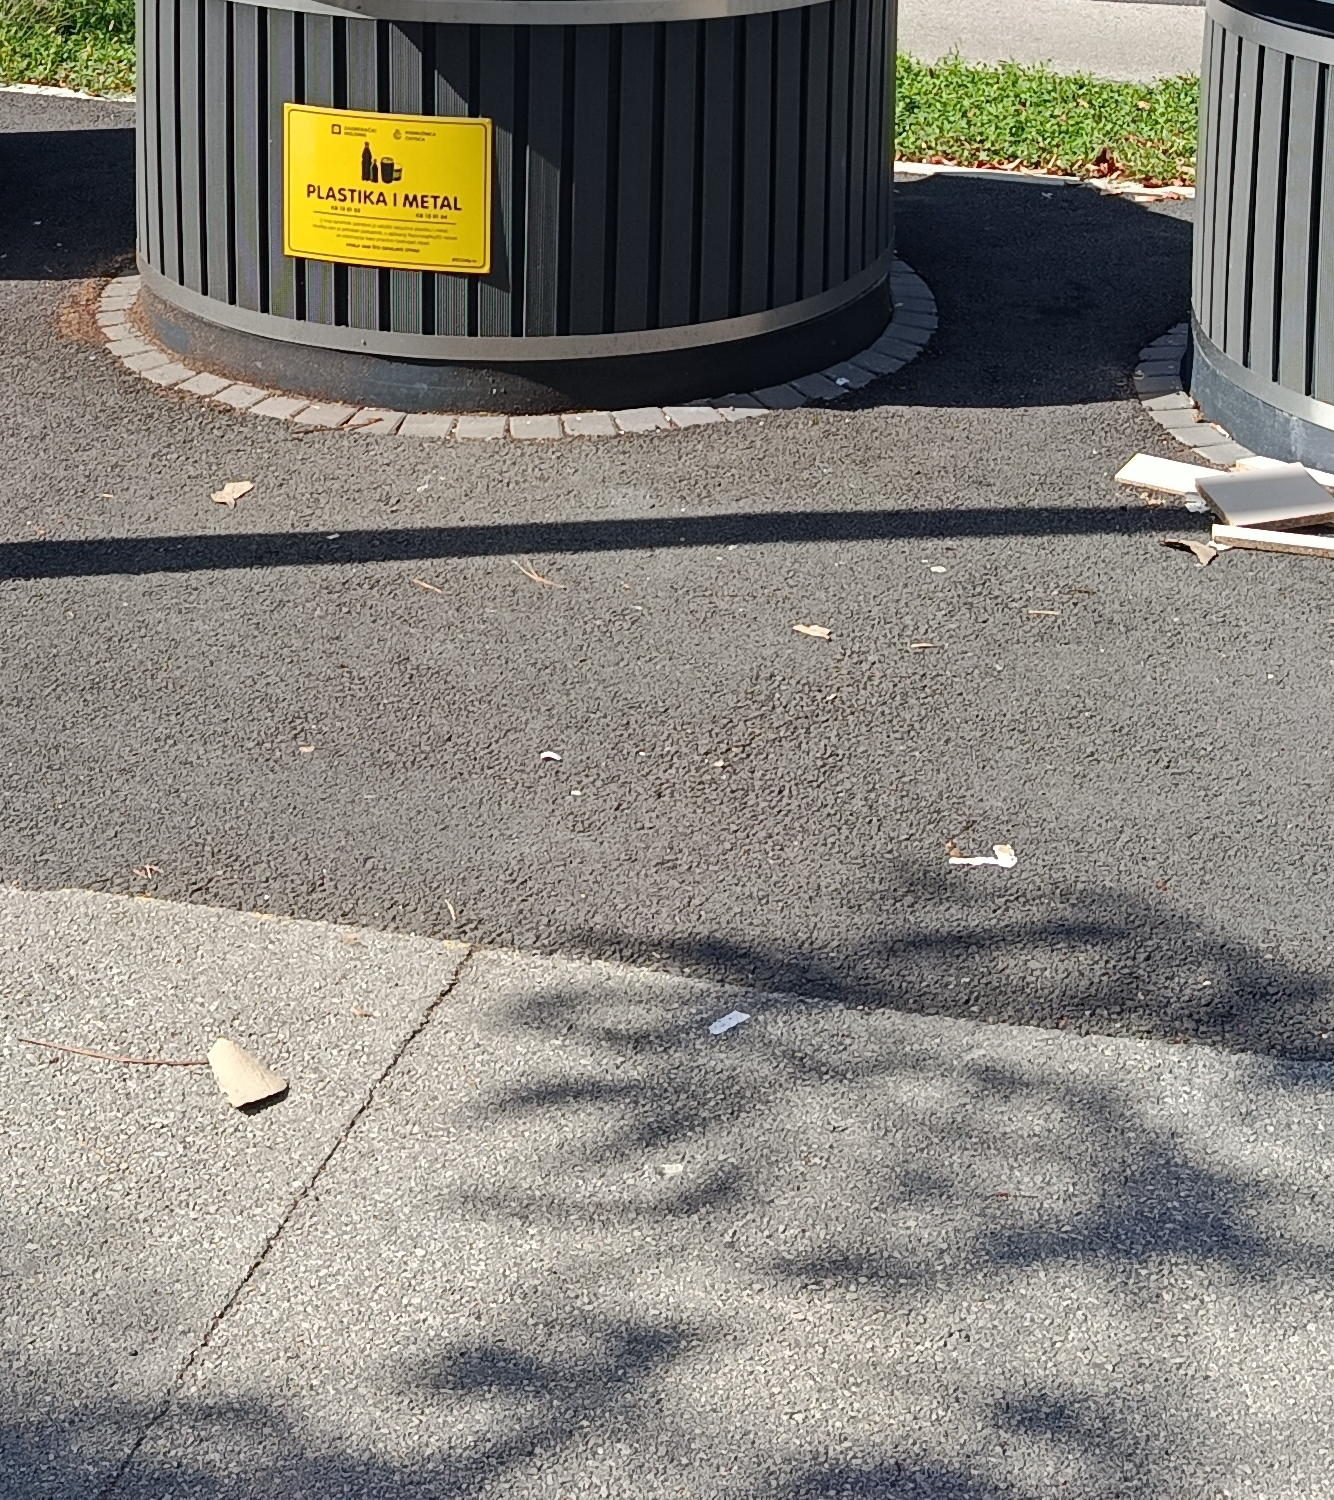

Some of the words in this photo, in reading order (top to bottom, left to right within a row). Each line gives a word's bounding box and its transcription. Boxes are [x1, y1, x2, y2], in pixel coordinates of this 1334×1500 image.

[306, 183, 388, 207] PLASTIKA
[393, 192, 397, 208] I
[402, 193, 463, 212] METAL
